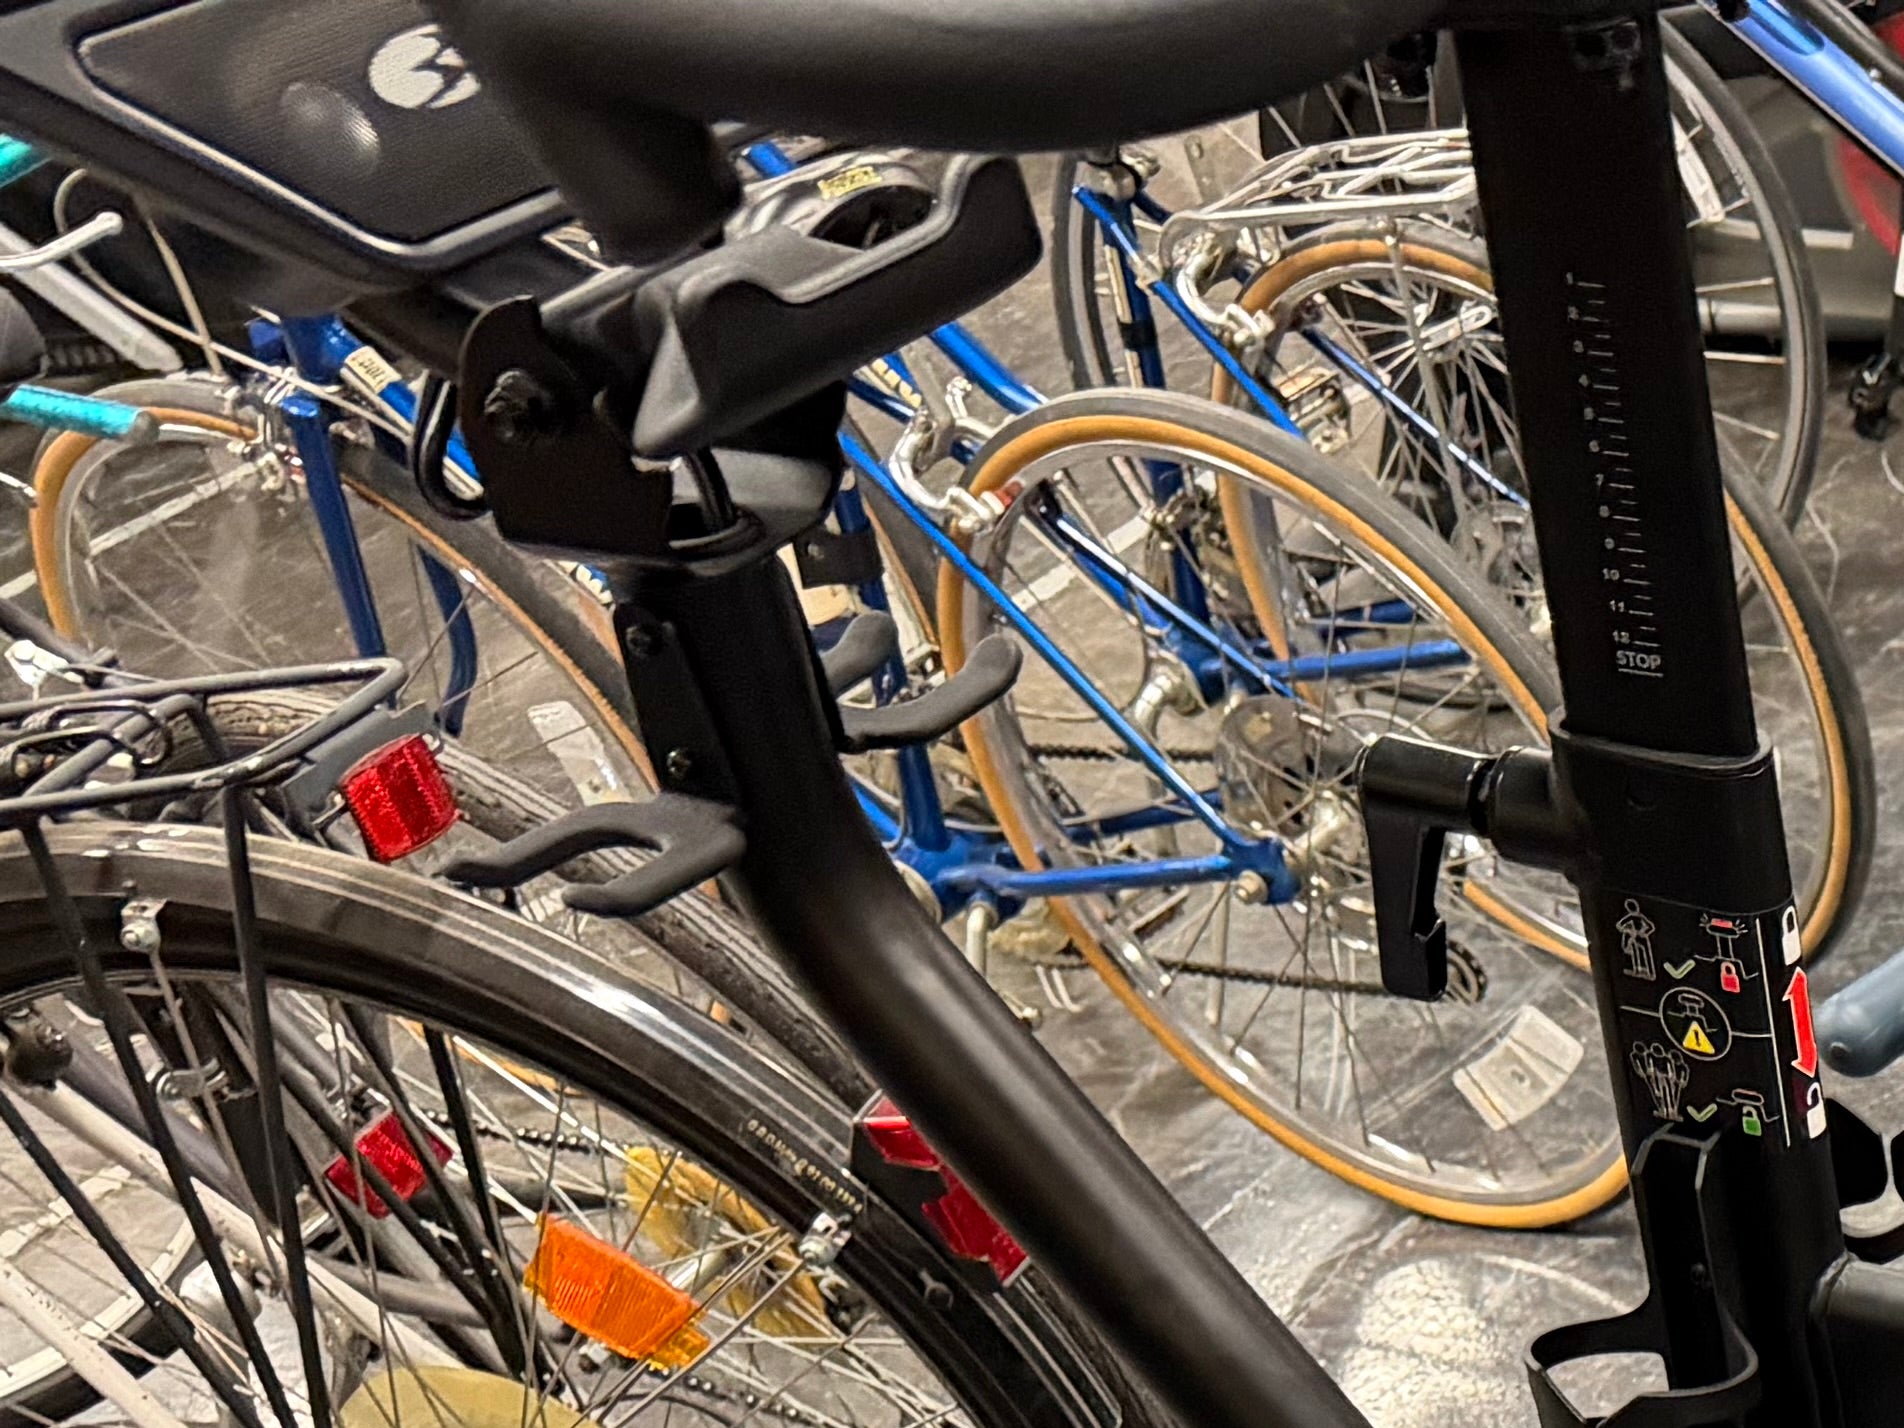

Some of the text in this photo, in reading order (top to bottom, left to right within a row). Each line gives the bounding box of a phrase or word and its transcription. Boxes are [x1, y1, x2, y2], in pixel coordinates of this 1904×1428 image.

[1602, 568, 1620, 581] 10
[1609, 600, 1625, 612] 11
[1616, 650, 1662, 669] STOP
